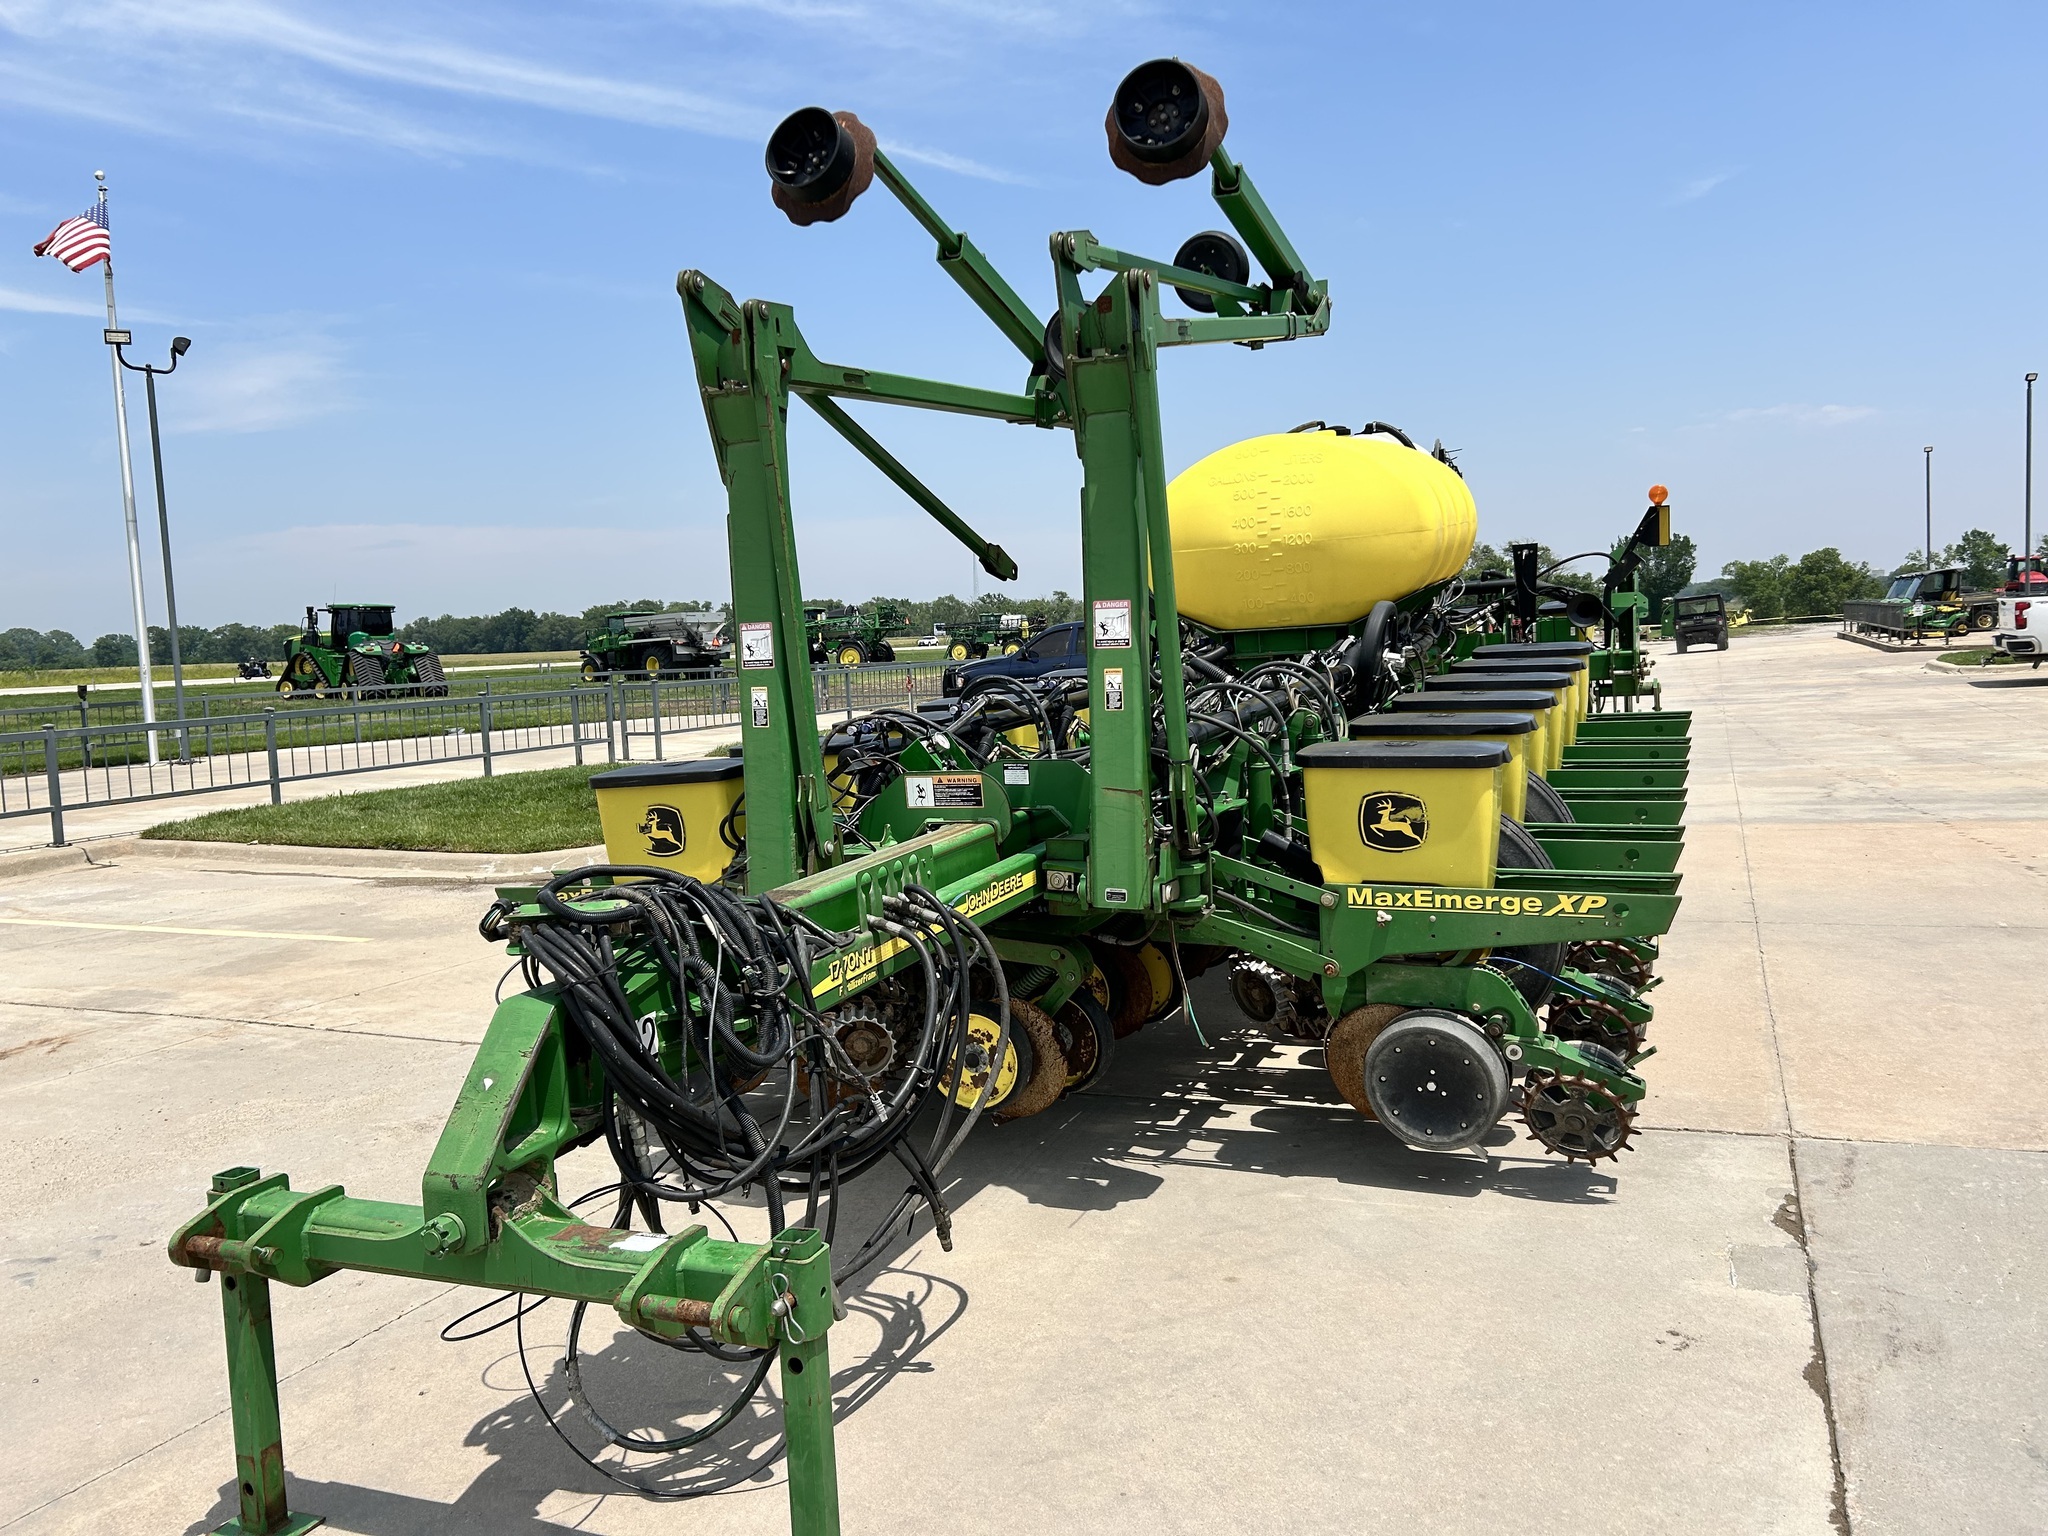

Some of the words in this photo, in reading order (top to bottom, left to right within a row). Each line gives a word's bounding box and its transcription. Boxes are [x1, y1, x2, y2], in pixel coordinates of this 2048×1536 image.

[1208, 472, 1257, 487] GALLONS
[1283, 473, 1315, 486] 2000
[1233, 488, 1256, 501] 500
[1283, 505, 1312, 518] 1600
[1232, 517, 1256, 530] 400
[1283, 532, 1313, 545] 1200
[1234, 542, 1257, 555] 300
[1285, 561, 1311, 574] 800
[1236, 570, 1260, 582] 200
[1243, 598, 1264, 609] 100
[1290, 592, 1315, 603] 400
[963, 887, 991, 914] JOHN
[990, 872, 1023, 901] DEERE
[1347, 887, 1543, 916] MaxEmerge
[1542, 894, 1607, 917] XP
